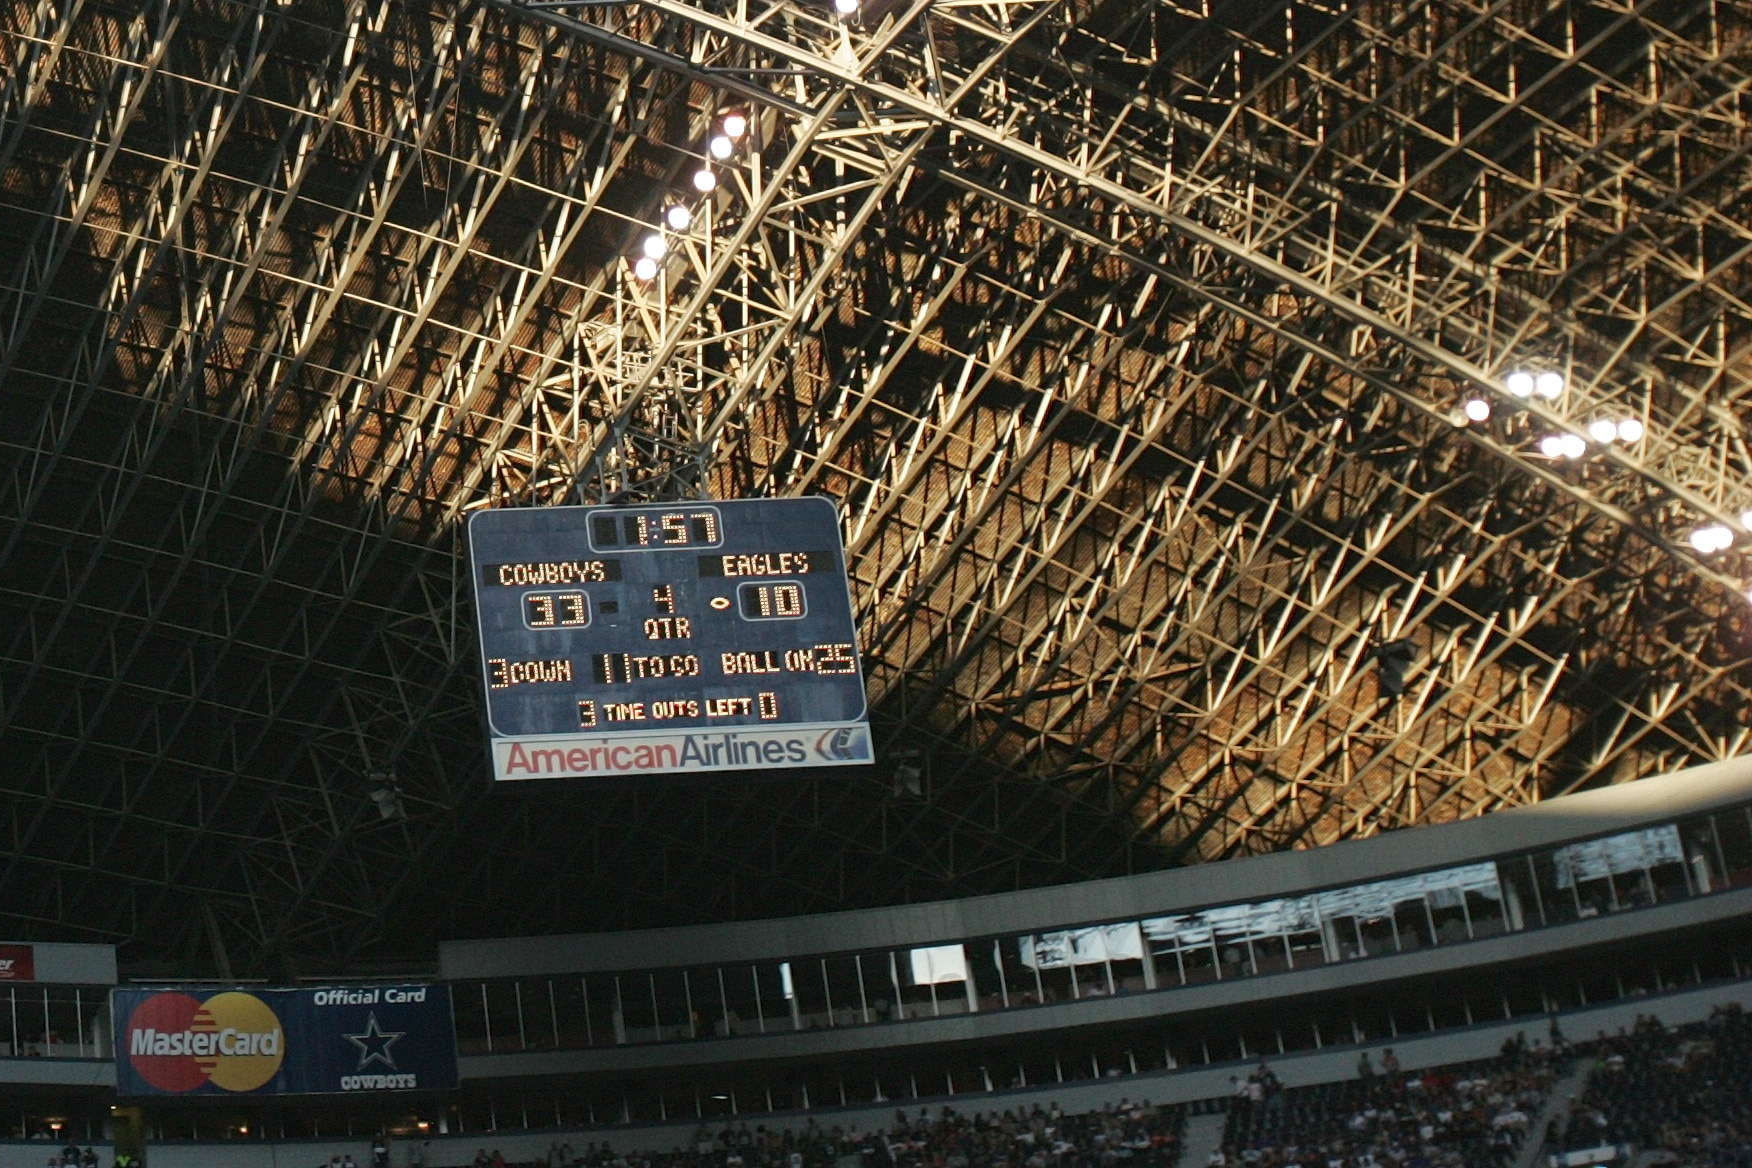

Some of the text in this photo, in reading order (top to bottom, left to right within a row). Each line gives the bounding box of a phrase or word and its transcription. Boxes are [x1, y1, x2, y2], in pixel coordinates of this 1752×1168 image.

[637, 513, 717, 546] 1:57
[499, 561, 605, 586] COWBOYS
[722, 552, 810, 577] EAGLES
[528, 594, 585, 627] 33
[653, 584, 675, 615] 4
[758, 585, 802, 617] 10
[644, 617, 691, 640] QTR
[488, 643, 856, 689] 3 DOWN 11 TO GO BALL ON 25
[578, 692, 778, 728] 3 TIME OUTS LEFT 0
[313, 987, 427, 1006] Official Card
[130, 1028, 280, 1057] MasterCard
[341, 1073, 418, 1090] COWBOYS
